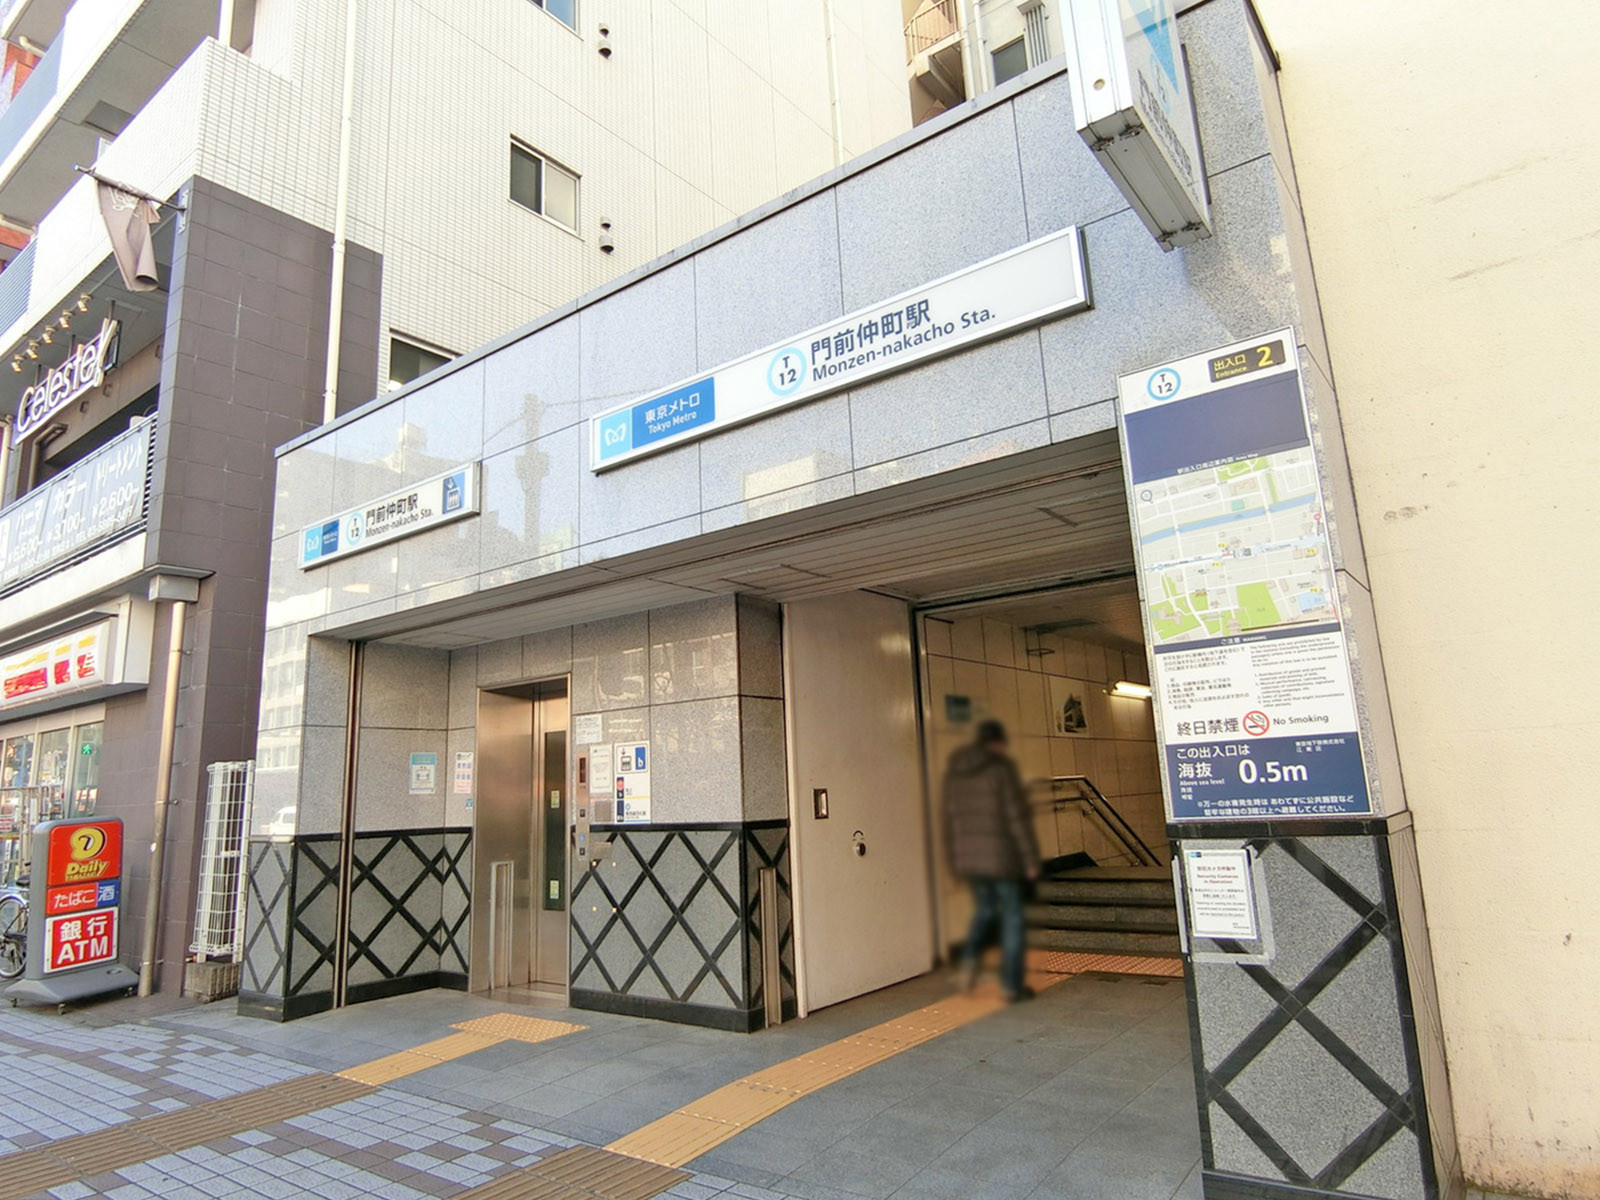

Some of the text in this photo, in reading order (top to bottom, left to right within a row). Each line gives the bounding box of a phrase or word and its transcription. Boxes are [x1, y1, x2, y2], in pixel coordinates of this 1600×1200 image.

[810, 299, 931, 366] 門前仲町駅
[812, 308, 996, 382] Monzen-nakacho Sta.
[782, 355, 790, 369] T
[1213, 346, 1274, 371] 出入口 2
[778, 369, 797, 386] 12
[1159, 374, 1166, 383] T
[1215, 366, 1248, 379] Entrance
[1157, 382, 1173, 394] 12
[644, 392, 700, 424] 東京メトロ
[648, 411, 698, 434] Tokyo Metro
[366, 493, 418, 528] 門前仲町駅
[1177, 718, 1239, 736] 終日禁煙
[1273, 714, 1329, 725] No Smoking
[1177, 744, 1251, 759] この出入口は
[1177, 761, 1213, 778] 海抜
[1238, 758, 1309, 784] 0.5m
[66, 859, 109, 878] Daily
[54, 885, 115, 909] たばこ 酒
[60, 915, 108, 942] 銀行
[57, 935, 108, 964] ATM
